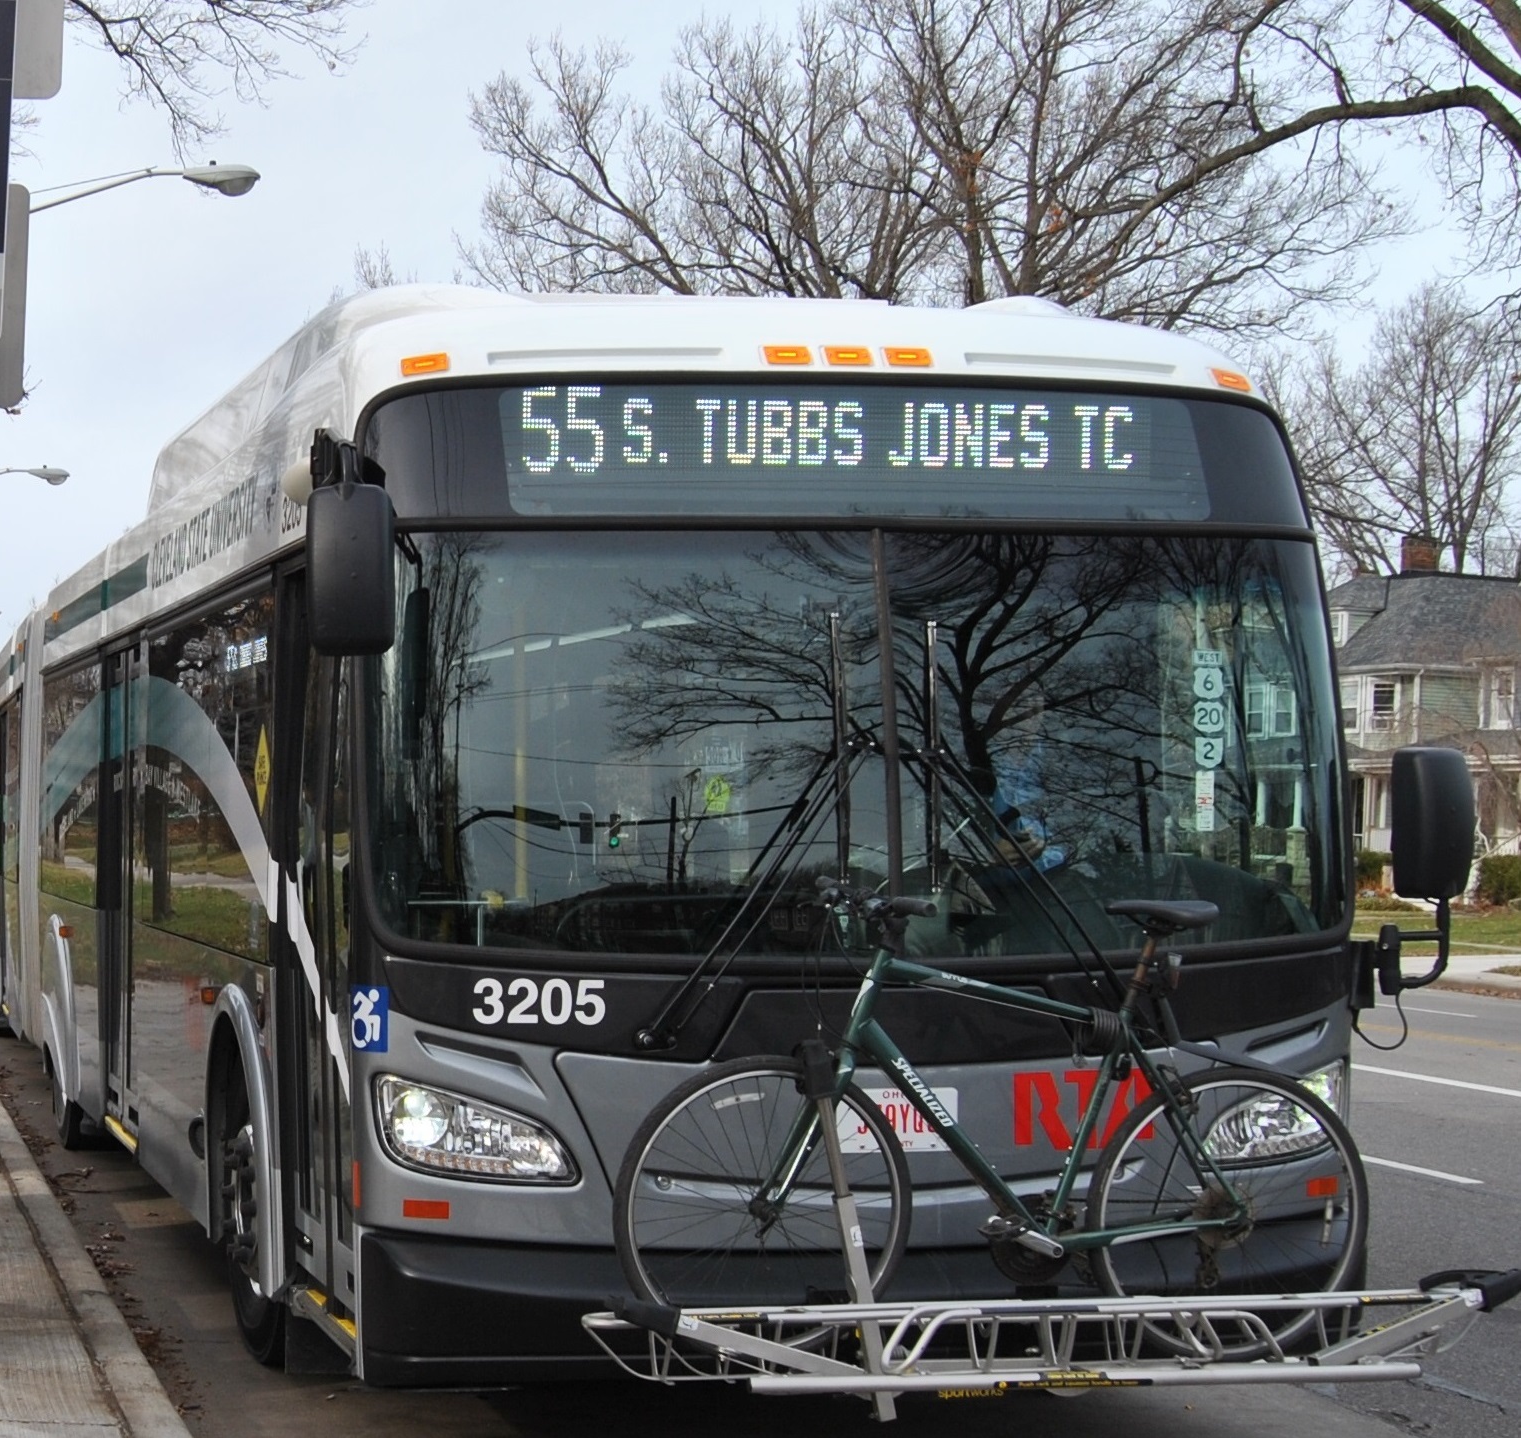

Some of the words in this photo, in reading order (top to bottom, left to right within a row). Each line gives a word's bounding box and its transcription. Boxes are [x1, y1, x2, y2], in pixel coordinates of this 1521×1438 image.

[521, 386, 604, 475] 55
[622, 398, 668, 464] S.
[696, 398, 864, 467] TUBBS
[889, 402, 1049, 468] JONES
[1073, 406, 1134, 470] TC
[186, 507, 211, 571] STATE
[1197, 652, 1220, 663] WEST
[1203, 674, 1214, 691] 6
[1197, 708, 1220, 726] 20
[1203, 742, 1215, 760] 2
[472, 977, 606, 1026] 3205
[891, 1057, 954, 1127] SPECIALIZED
[938, 1388, 1004, 1400] sportworks
